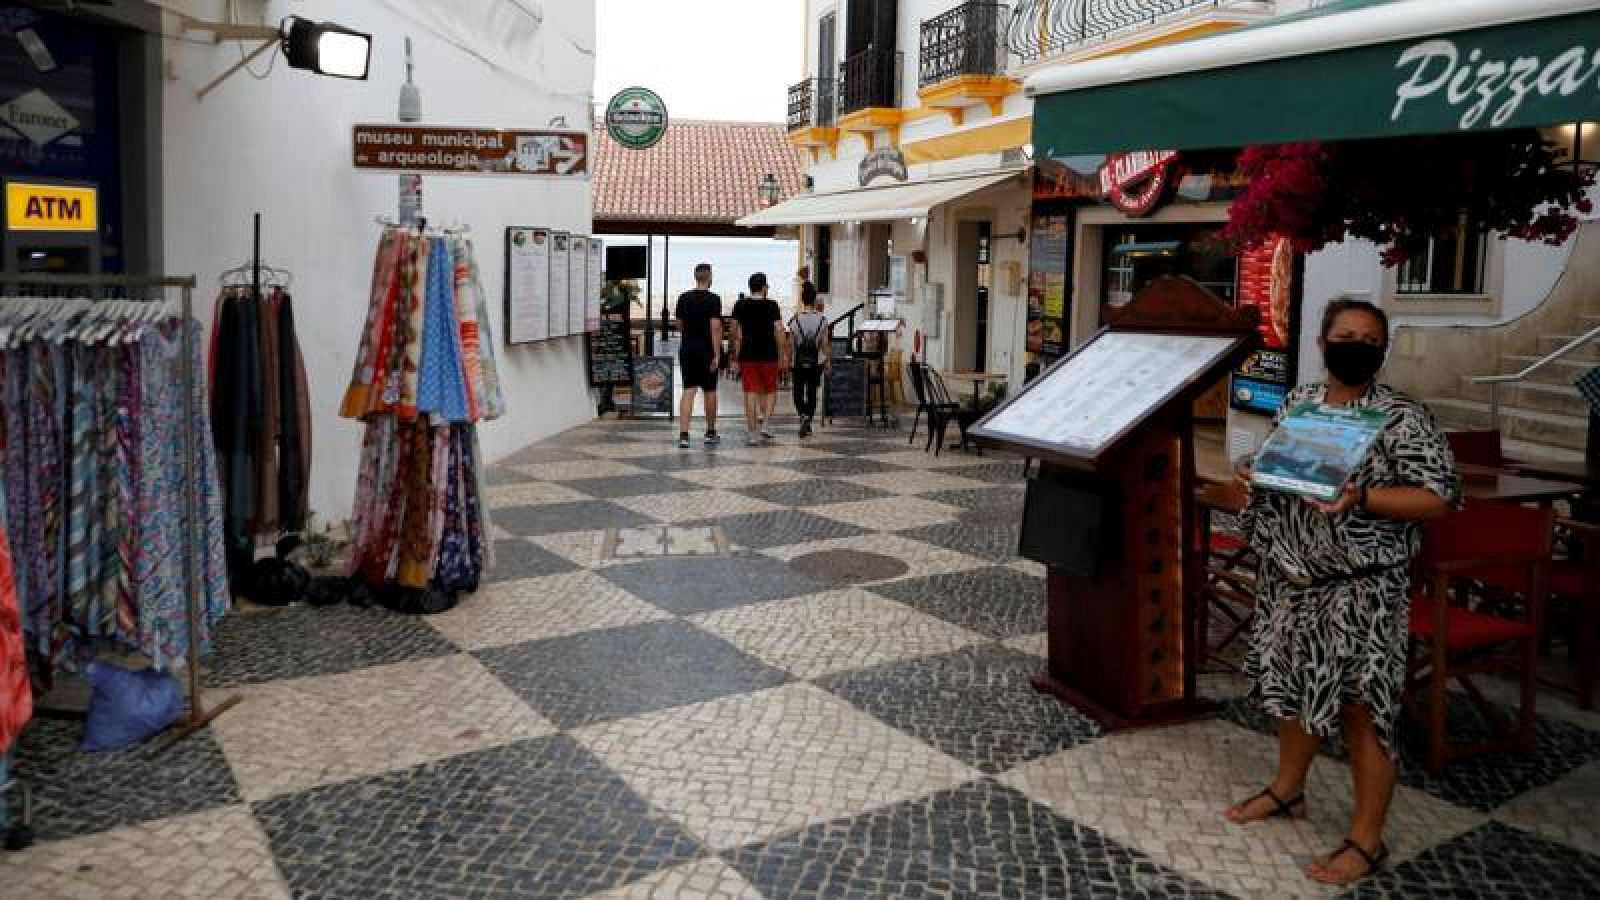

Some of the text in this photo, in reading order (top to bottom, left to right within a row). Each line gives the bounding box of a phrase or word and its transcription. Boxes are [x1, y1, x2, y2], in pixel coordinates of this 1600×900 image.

[356, 131, 502, 149] museu municipal
[378, 150, 479, 169] arqueologia
[24, 195, 83, 221] ATM
